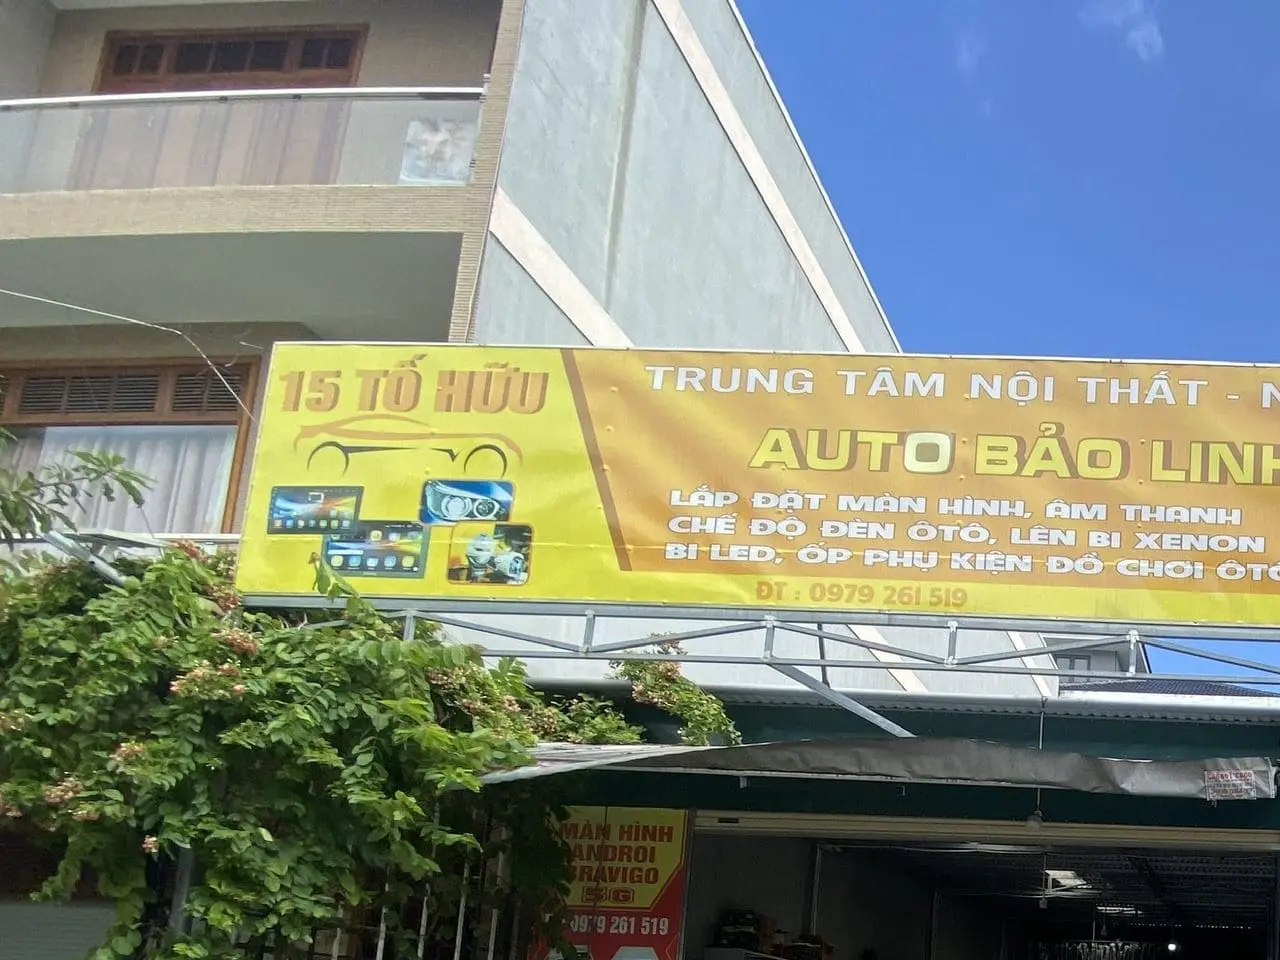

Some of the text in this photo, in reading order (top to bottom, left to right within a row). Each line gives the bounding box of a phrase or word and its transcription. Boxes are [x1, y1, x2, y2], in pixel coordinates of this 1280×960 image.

[279, 353, 549, 414] 15 TỐ HỮU
[645, 365, 815, 395] TRUNG
[837, 366, 946, 398] TÂM
[969, 370, 1055, 407] NỘI
[1077, 370, 1209, 407] THẤT
[748, 427, 953, 475] AUTO
[974, 421, 1127, 481] BẢO
[669, 484, 1242, 526] LẮP ĐẶT MÀN HÌNH, ÂM THANH
[668, 512, 1266, 553] CHẾ ĐỘ ĐÈN ÔTÔ, LÊN BI XENON
[665, 542, 698, 560] BI
[709, 544, 785, 565] LED,
[796, 541, 853, 565] ỐP
[863, 548, 939, 573] PHỤ
[950, 550, 1033, 575] KIỆN
[1046, 552, 1105, 576] ĐỒ
[1116, 560, 1205, 580] CHƠI
[756, 581, 787, 601] ĐT
[809, 583, 875, 604] 0979
[883, 585, 921, 606] 261
[929, 587, 968, 608] 519
[560, 819, 674, 843] MÀN HÌNH
[609, 916, 636, 935] 261
[641, 916, 669, 936] 519
